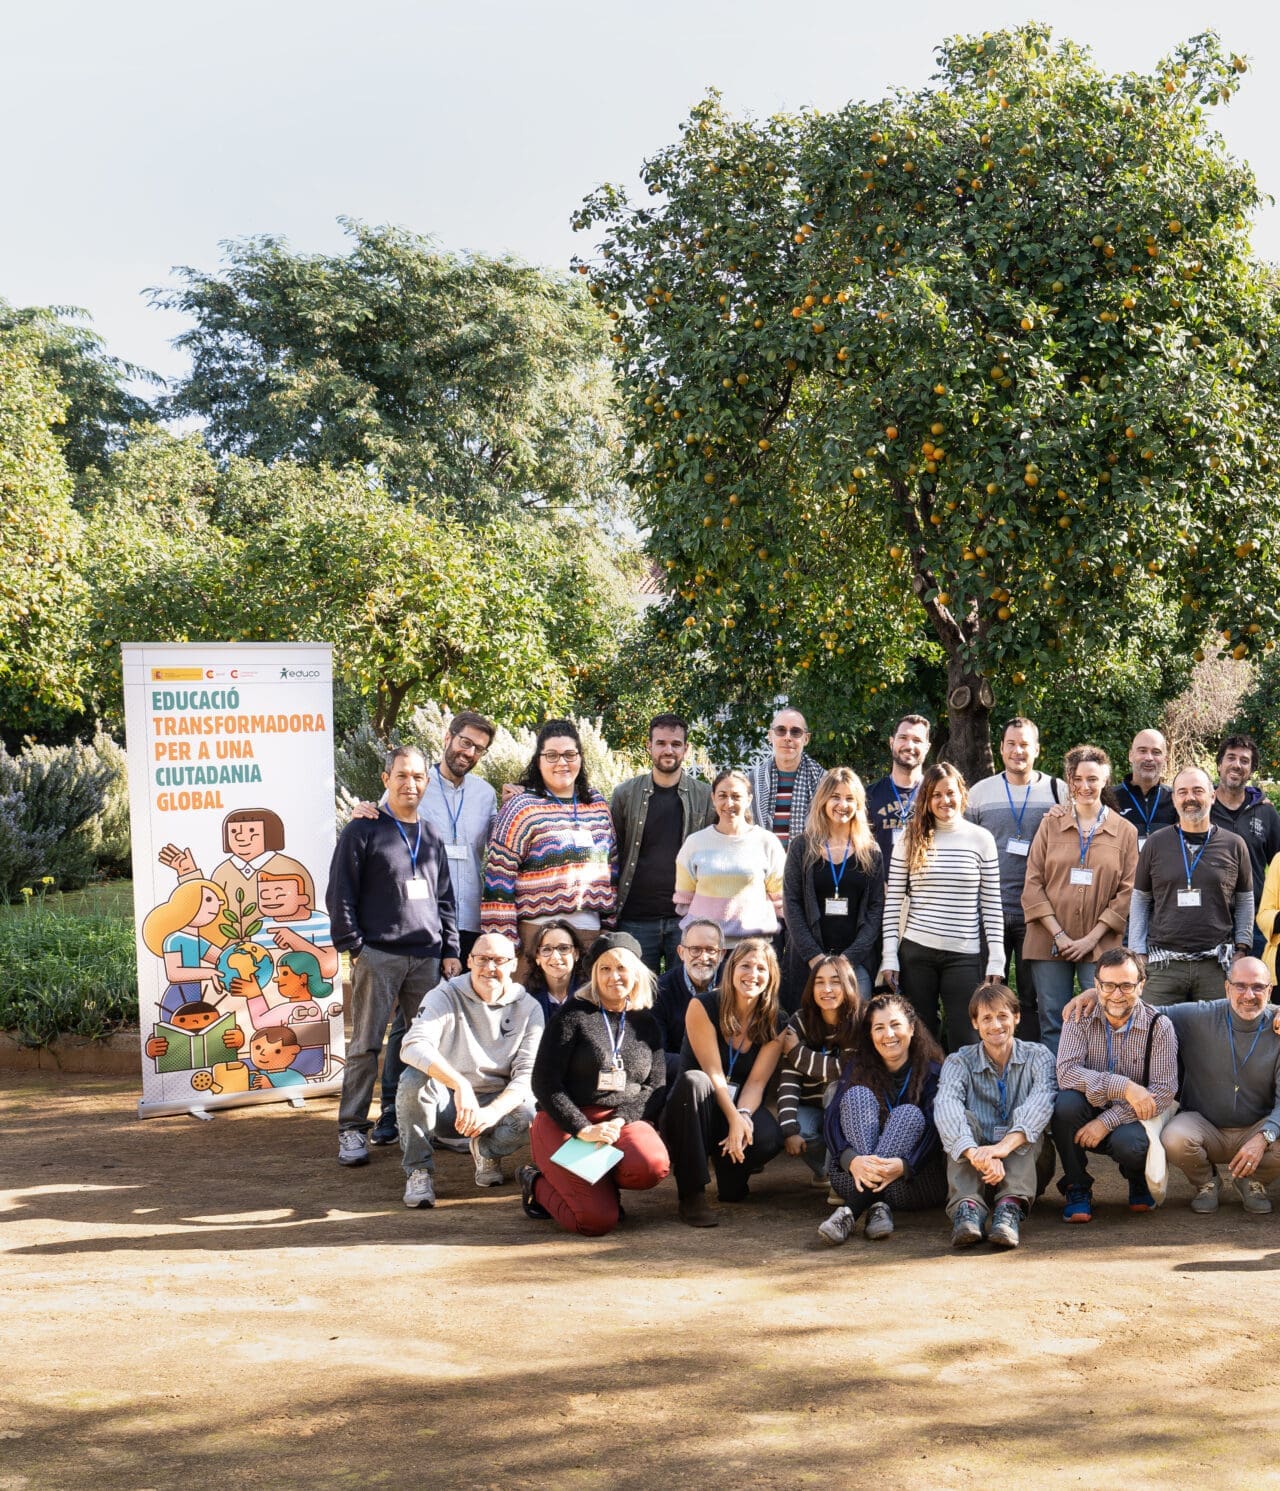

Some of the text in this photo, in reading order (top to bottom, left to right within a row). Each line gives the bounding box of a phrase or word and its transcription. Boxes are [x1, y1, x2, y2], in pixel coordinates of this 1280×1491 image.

[289, 669, 320, 678] educo
[152, 687, 240, 711] EDUCACIÓ
[153, 713, 326, 736] TRANSFORMADORA
[154, 739, 255, 761] PER A UNA
[155, 764, 263, 786] CIUTADANIA
[156, 790, 225, 812] GLOBAL
